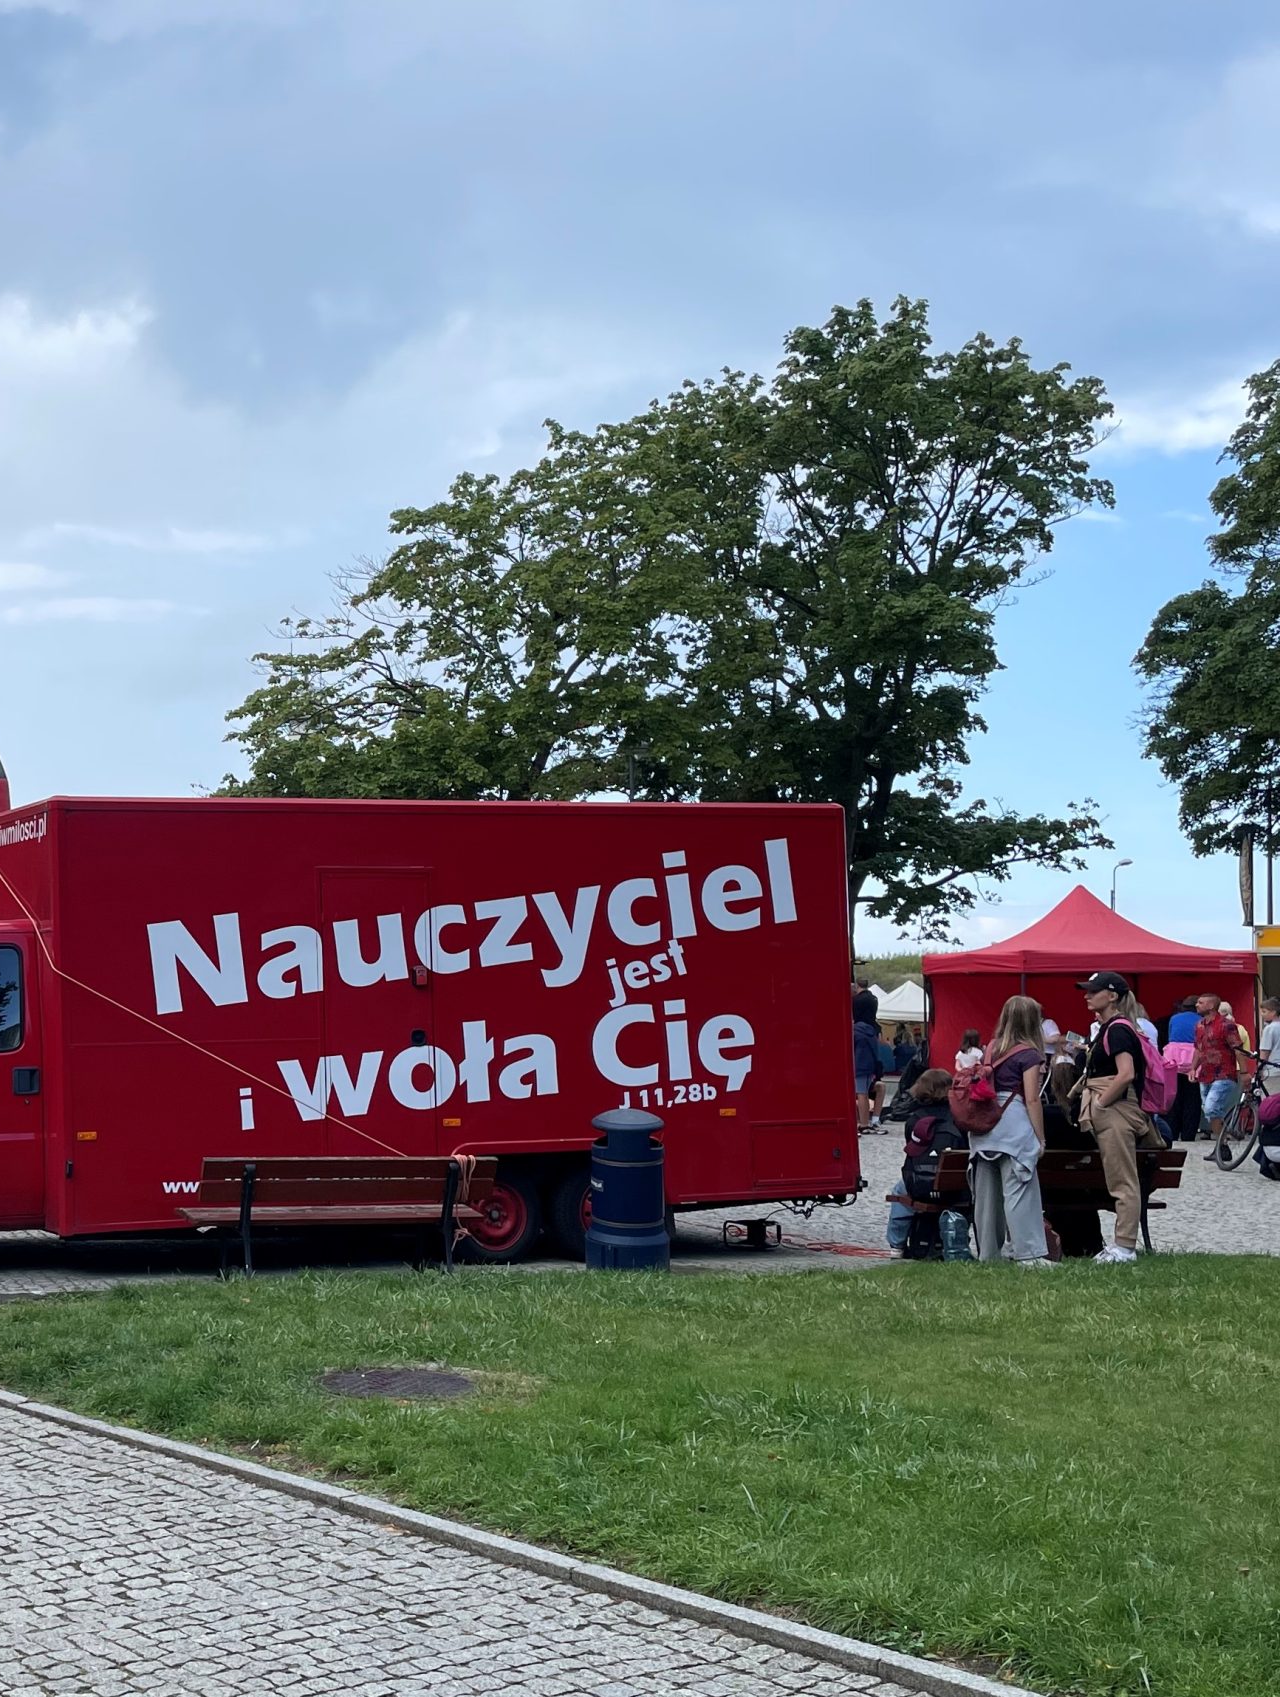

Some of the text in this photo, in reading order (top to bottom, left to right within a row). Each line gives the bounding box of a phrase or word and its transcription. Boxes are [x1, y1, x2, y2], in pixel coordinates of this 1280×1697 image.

[147, 838, 798, 1016] Nauczyciel
[606, 939, 688, 1008] jest
[239, 999, 755, 1131] i woła Cię
[619, 1083, 717, 1109] J 11,28b
